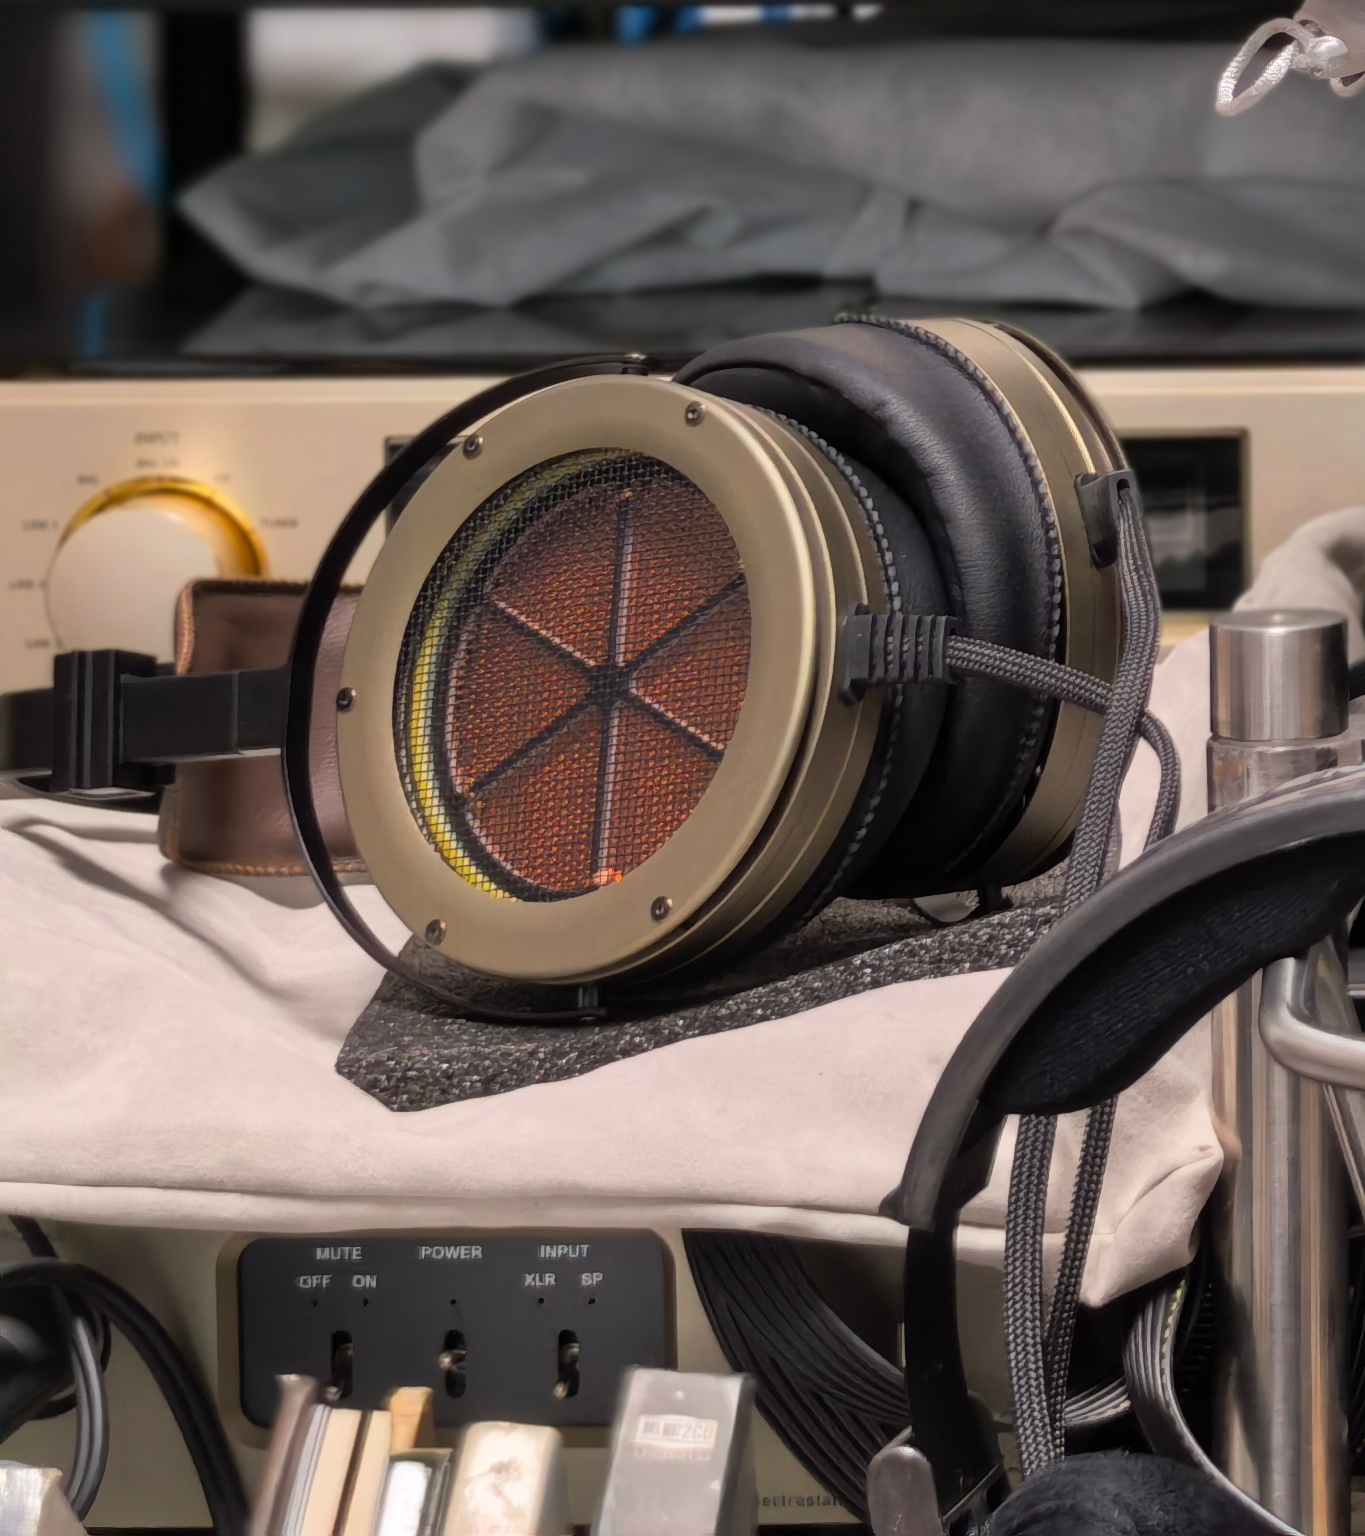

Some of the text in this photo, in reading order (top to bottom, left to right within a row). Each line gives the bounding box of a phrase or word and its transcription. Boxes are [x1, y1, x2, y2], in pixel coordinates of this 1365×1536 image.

[316, 1246, 363, 1261] MUTE
[421, 1245, 483, 1260] POWER
[540, 1244, 590, 1259] INPUT
[297, 1274, 333, 1289] OFF
[351, 1274, 377, 1289] ON
[524, 1272, 557, 1288] XLR
